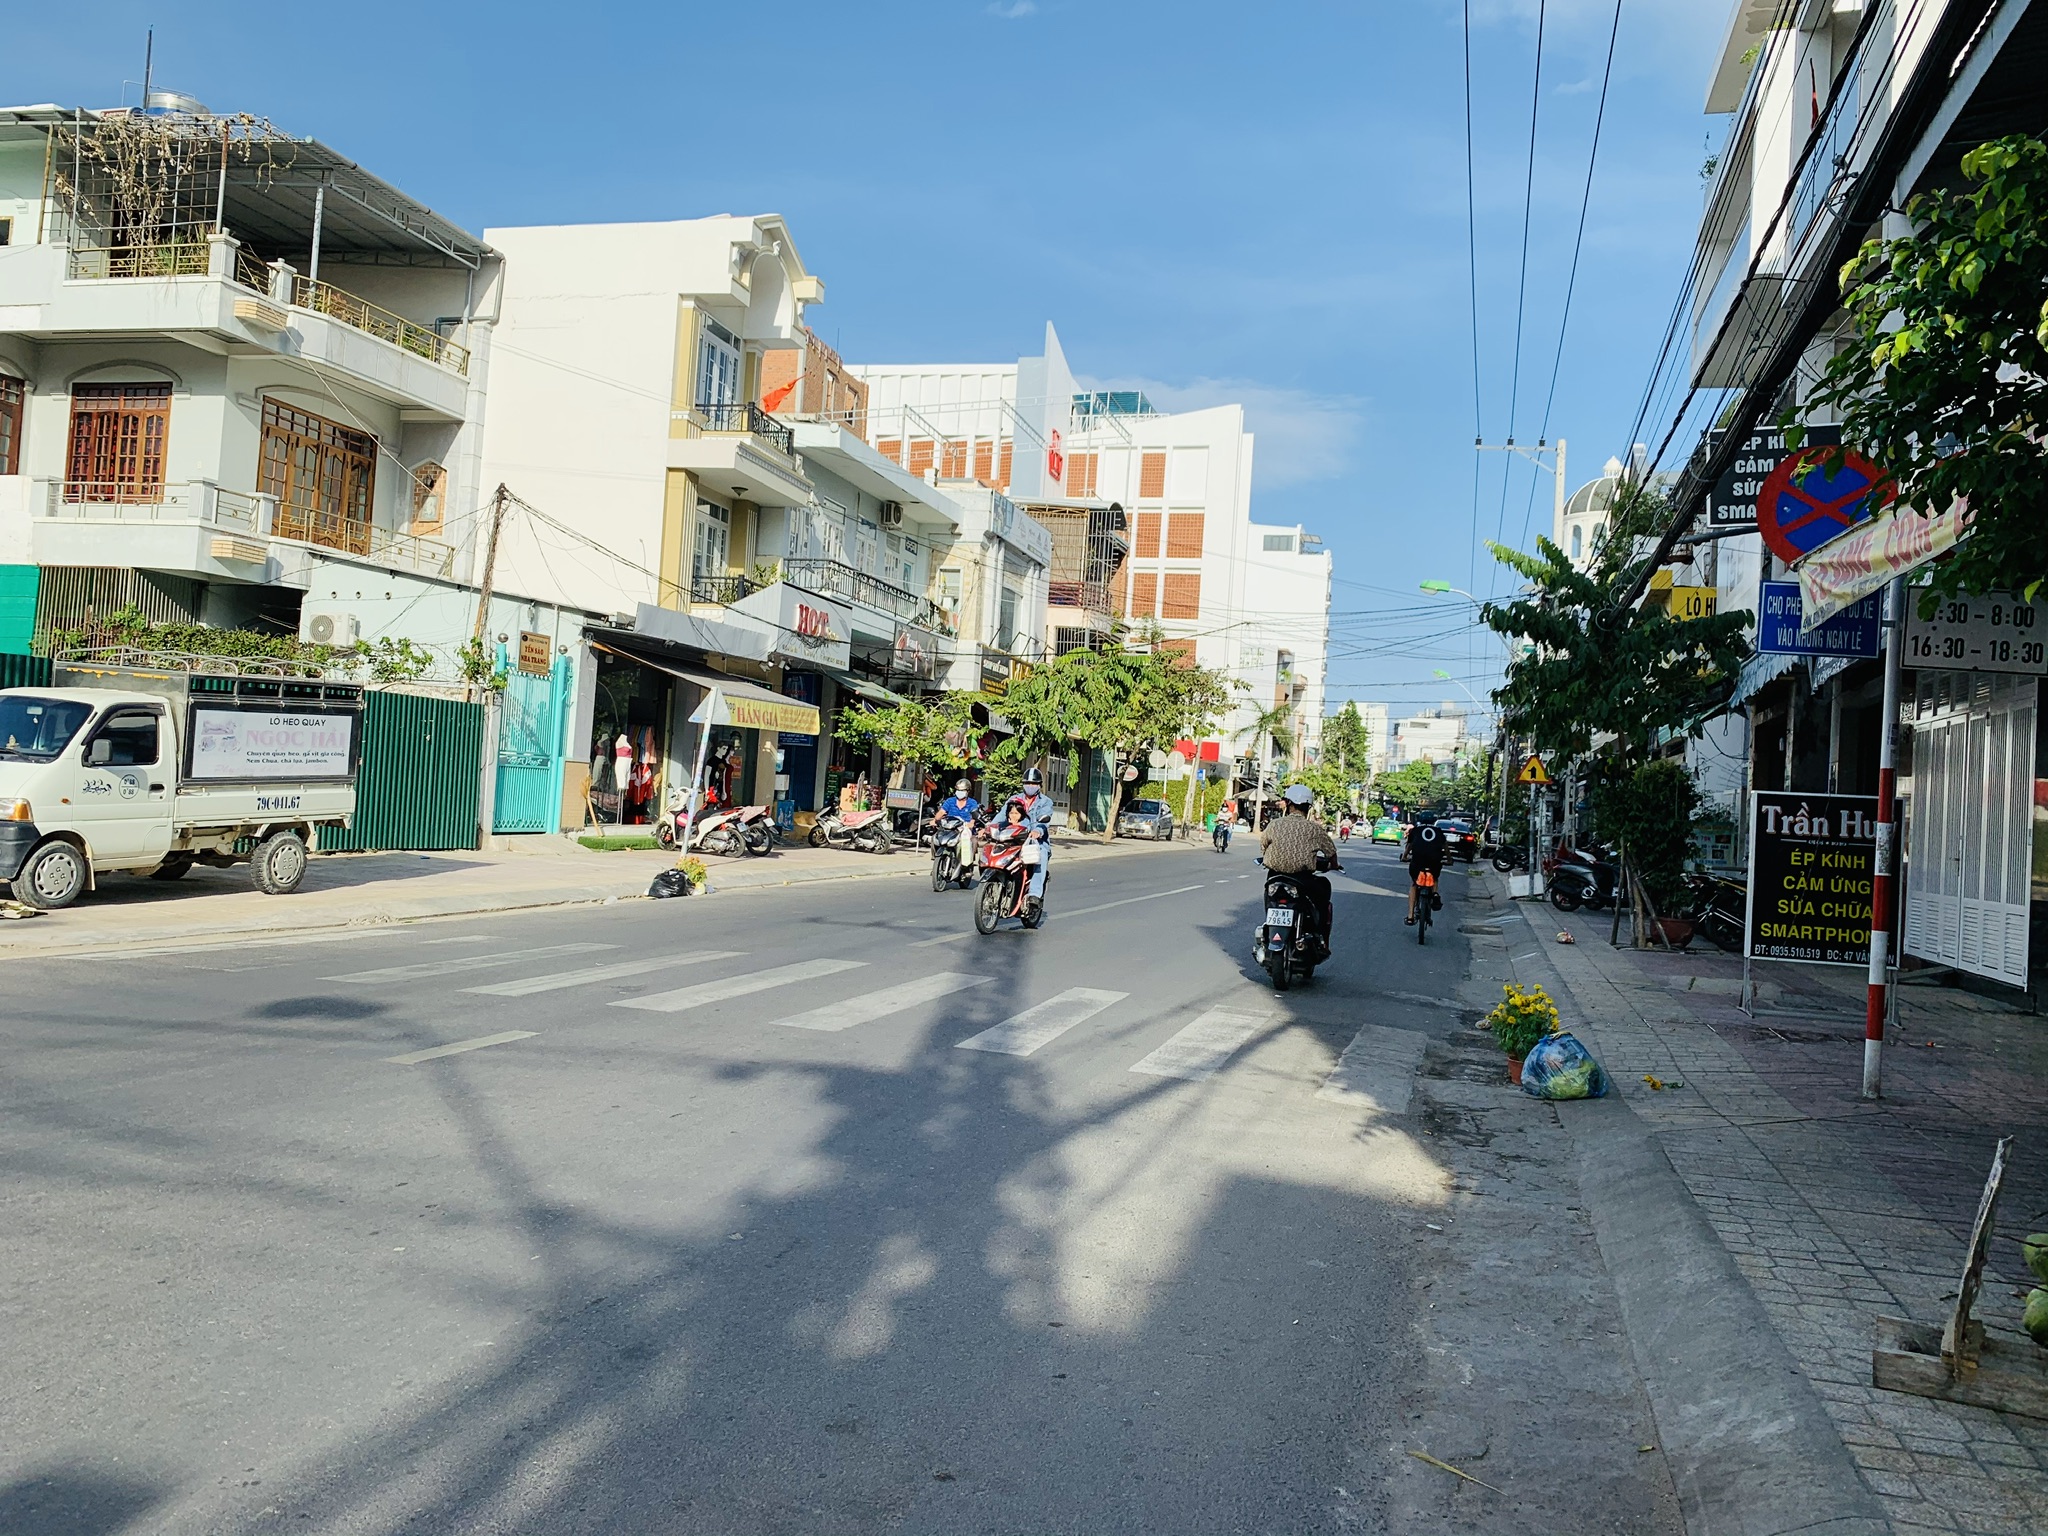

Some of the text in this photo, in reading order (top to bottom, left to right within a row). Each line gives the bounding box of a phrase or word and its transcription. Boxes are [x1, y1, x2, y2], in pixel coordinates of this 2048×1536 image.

[1735, 455, 1774, 474] CẢM
[1718, 504, 1757, 519] SMA
[1686, 592, 1716, 616] LÒ H
[1862, 600, 1874, 619] XE
[1926, 602, 1968, 624] :30
[1992, 604, 2034, 628] 8:00
[798, 604, 828, 637] HOT
[1777, 624, 1793, 647] VÀO
[1826, 627, 1849, 650] NGÀY
[1911, 636, 1965, 658] 16:30
[1989, 640, 2044, 664] 18:30
[283, 718, 300, 726] HEO
[302, 718, 326, 727] QUAY
[1762, 802, 1897, 840] Trần Hu
[1790, 848, 1866, 869] ÉP KÍNH
[1784, 871, 1870, 895] CẢM ỨNG
[1778, 895, 1873, 920] SỬA CHỮA
[1754, 944, 1768, 956] ĐT:
[1770, 945, 1820, 960] 0935.510.519
[1827, 950, 1842, 961] ĐC:
[1844, 951, 1853, 962] 47
